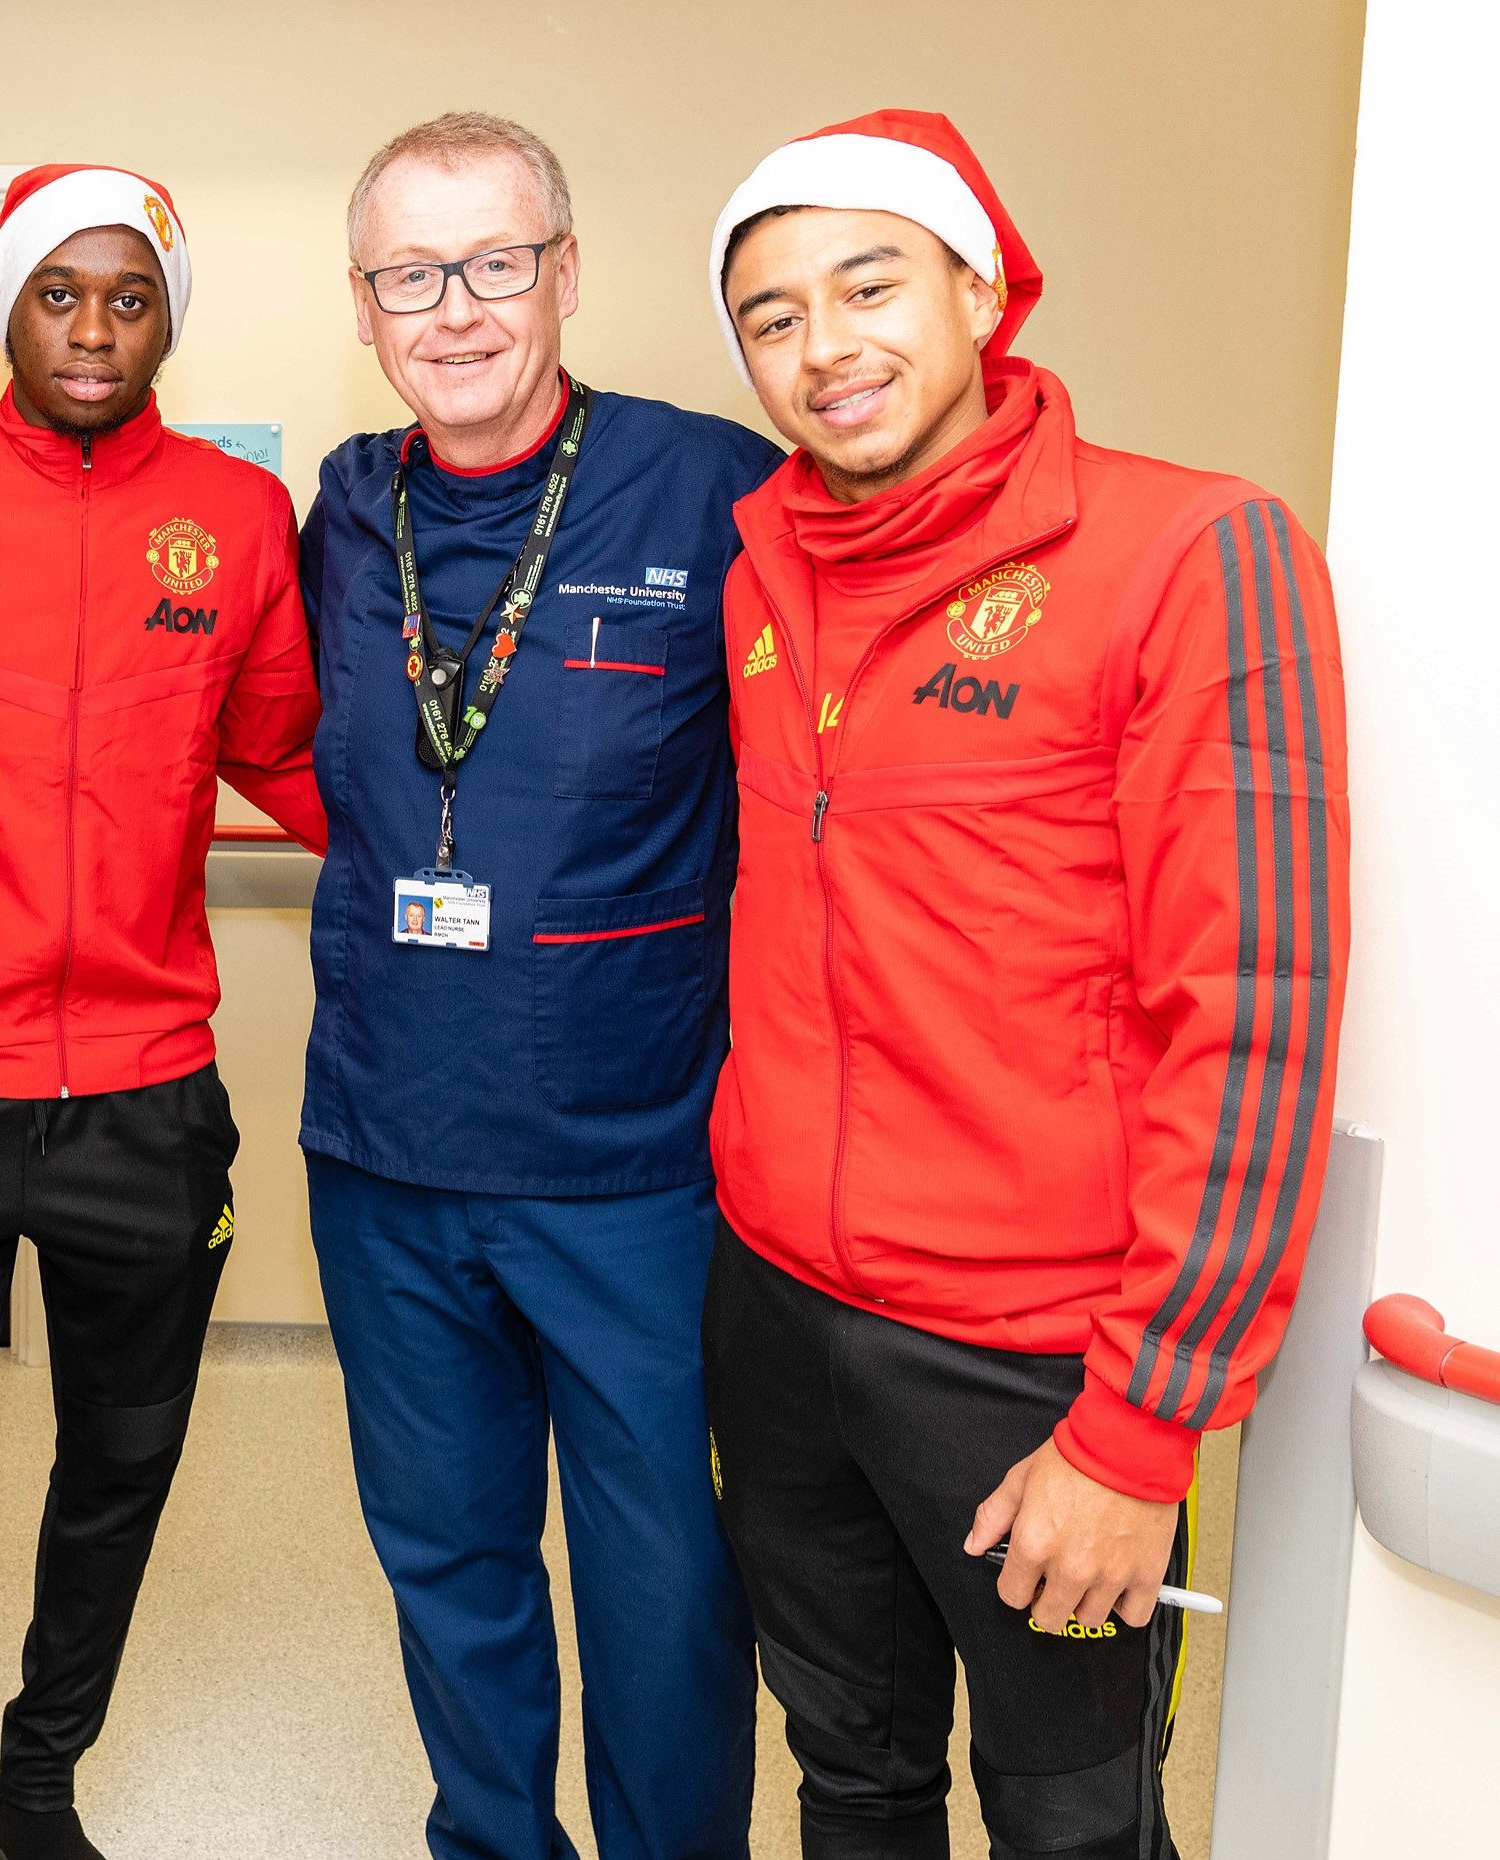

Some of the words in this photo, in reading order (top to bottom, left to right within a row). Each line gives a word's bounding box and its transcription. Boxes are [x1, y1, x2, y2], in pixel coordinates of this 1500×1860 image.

[548, 472, 560, 496] 4522
[154, 523, 212, 551] MANCHESTER
[162, 575, 204, 590] UNITED
[646, 568, 687, 588] NHS
[968, 569, 1044, 604] MANCHESTER
[558, 583, 627, 596] Manchester
[630, 586, 686, 603] University
[606, 596, 624, 604] NHS
[624, 598, 665, 608] Foundation
[667, 601, 686, 610] Trust
[956, 633, 1011, 654] UNITED
[743, 653, 778, 678] adidas
[480, 674, 490, 692] 016
[429, 699, 443, 722] 0161
[436, 722, 449, 740] 276
[466, 888, 486, 898] NHS
[434, 916, 460, 924] WALTER
[462, 918, 480, 926] TANN
